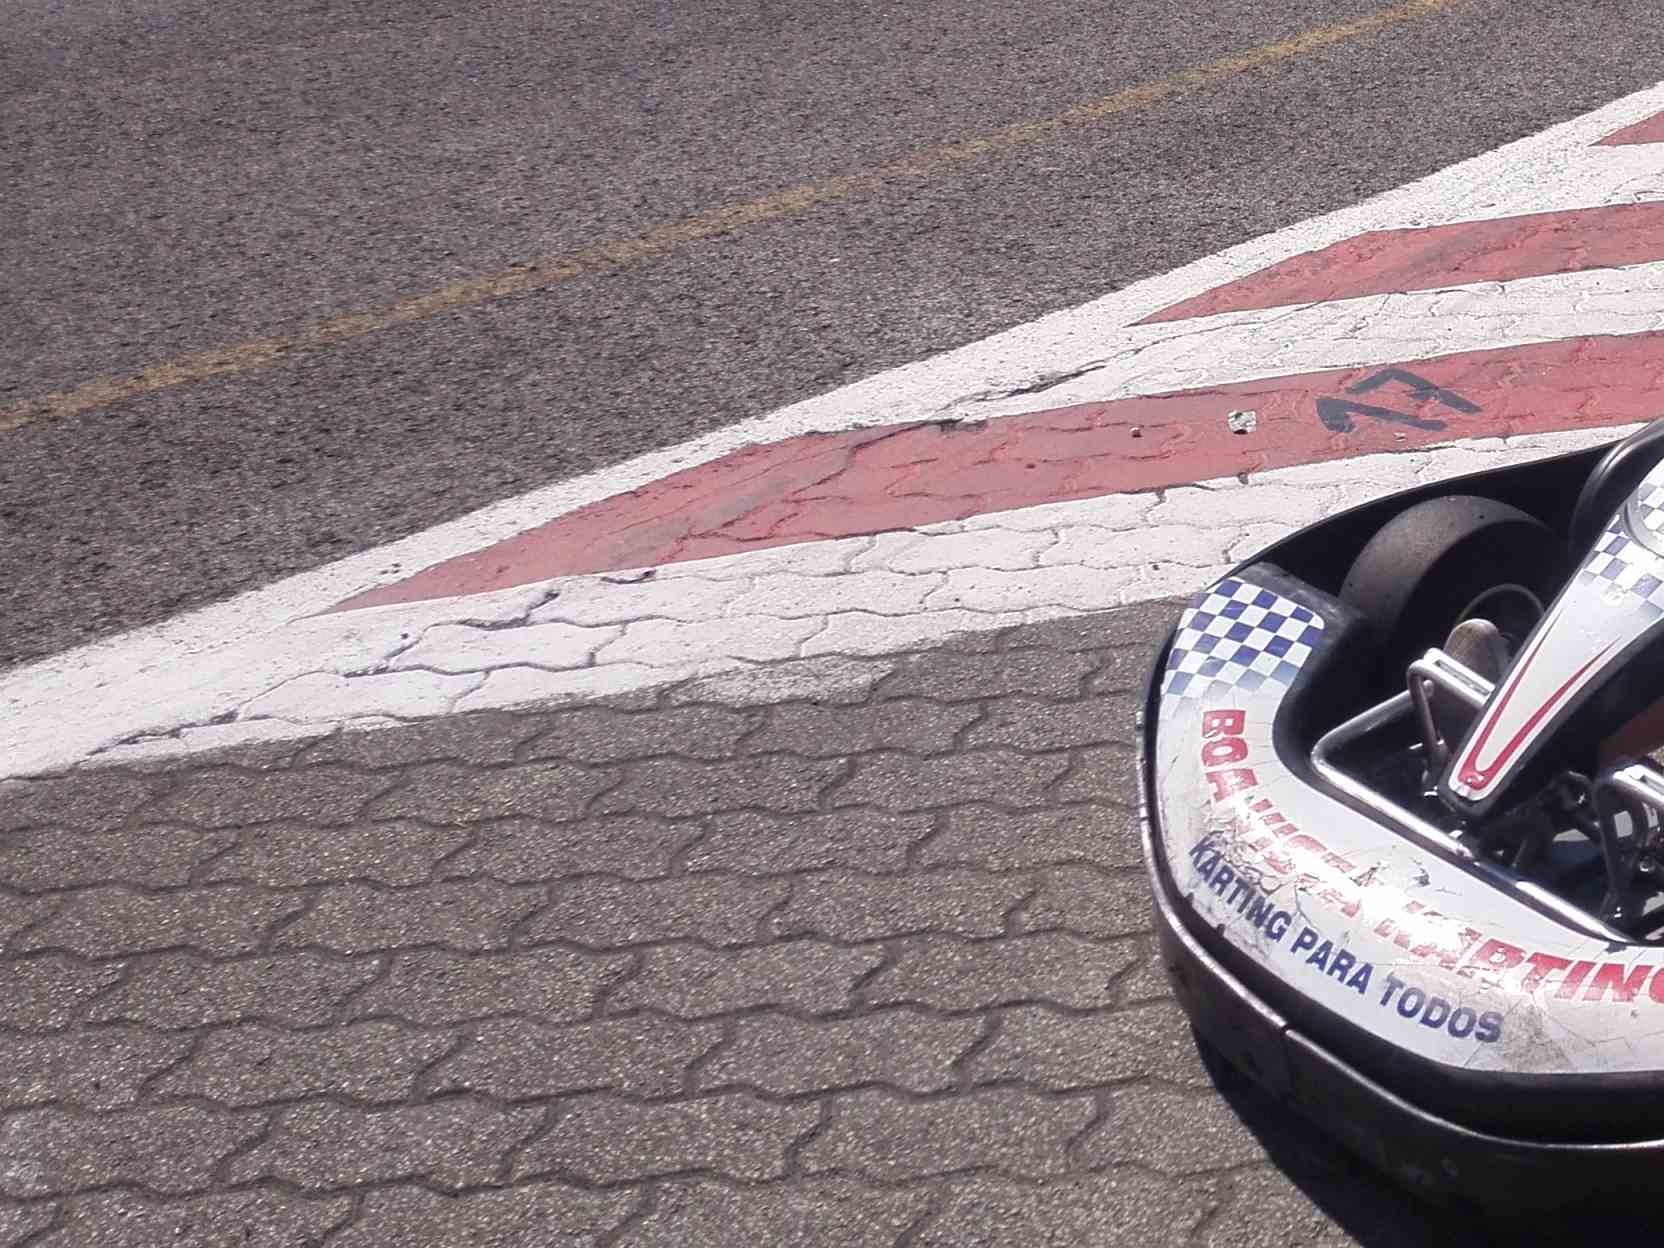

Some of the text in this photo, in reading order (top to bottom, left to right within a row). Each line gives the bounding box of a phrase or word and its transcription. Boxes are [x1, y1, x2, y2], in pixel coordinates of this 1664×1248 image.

[1200, 708, 1260, 802] BOA
[1189, 830, 1503, 1044] KARTING PARA TODOS
